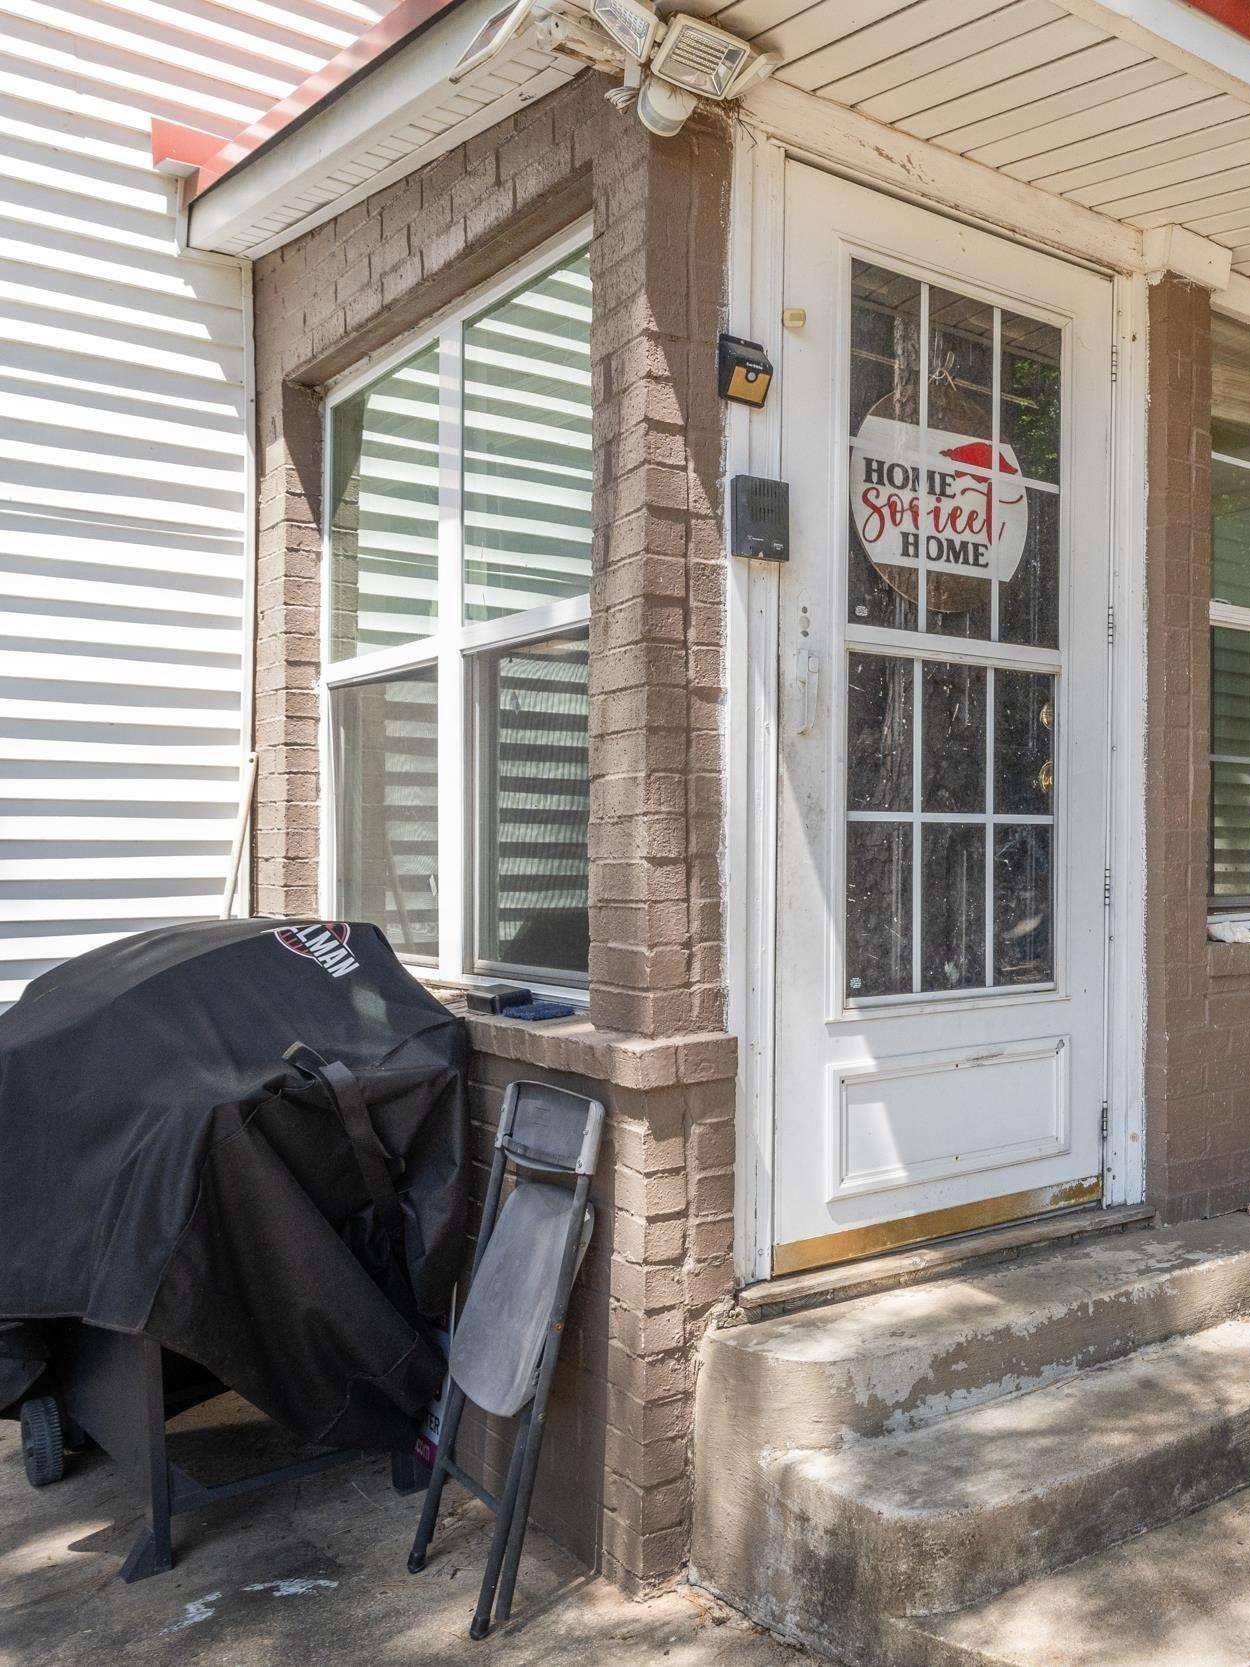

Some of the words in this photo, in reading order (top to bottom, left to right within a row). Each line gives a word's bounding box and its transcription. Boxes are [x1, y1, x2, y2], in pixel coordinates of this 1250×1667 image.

[862, 456, 957, 499] HOME
[900, 530, 990, 568] HOME
[288, 924, 360, 978] LMAN
